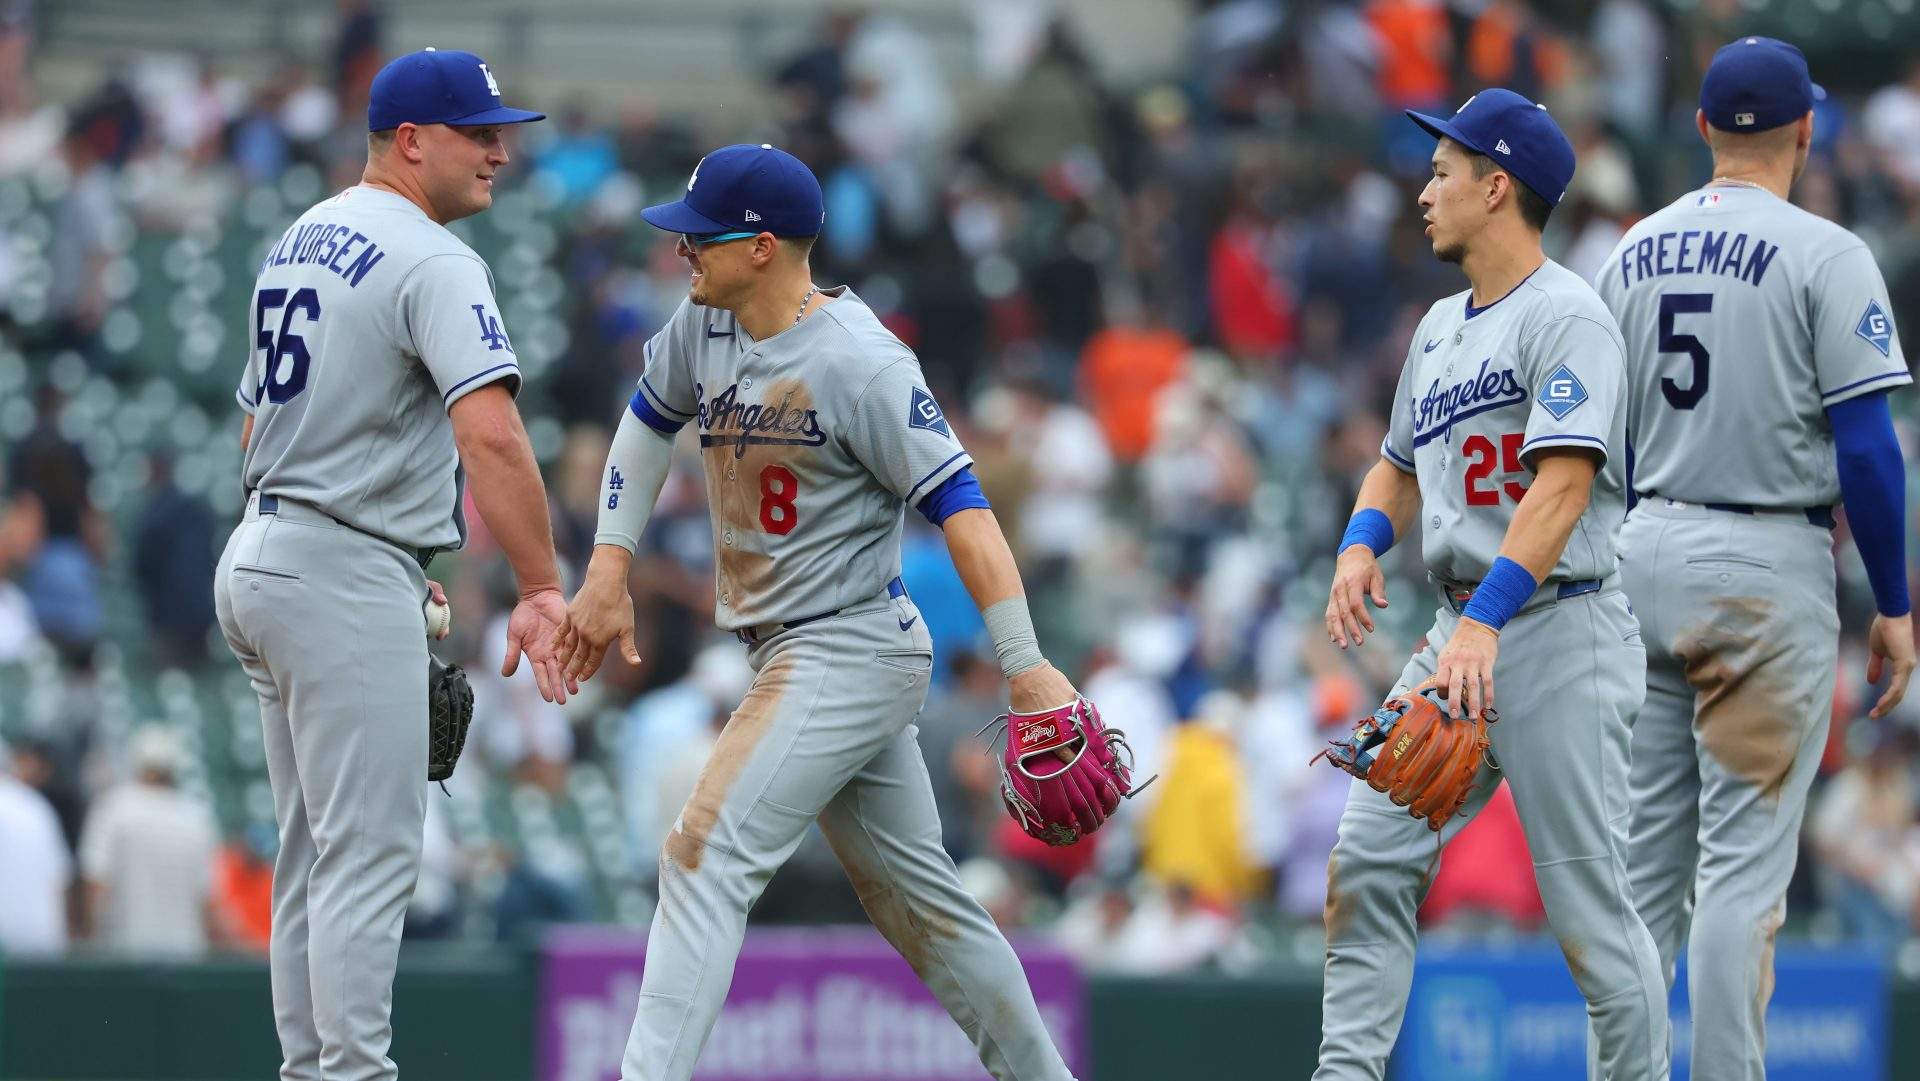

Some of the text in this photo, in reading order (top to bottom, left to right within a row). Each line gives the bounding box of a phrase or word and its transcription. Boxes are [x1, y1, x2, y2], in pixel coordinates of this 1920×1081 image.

[258, 223, 385, 288] ALVORSEN
[1621, 231, 1779, 289] FREEMAN
[255, 288, 321, 408] 56
[471, 304, 514, 353] LA
[1658, 293, 1714, 410] 5
[1869, 313, 1885, 334] G
[918, 398, 937, 420] G
[1416, 357, 1527, 444] Angeles
[1550, 379, 1572, 397] G
[704, 383, 827, 459] Angeles
[610, 466, 624, 489] LA
[1462, 433, 1536, 506] 25
[608, 493, 618, 510] 8
[759, 464, 798, 536] 8
[1392, 732, 1413, 760] A2K
